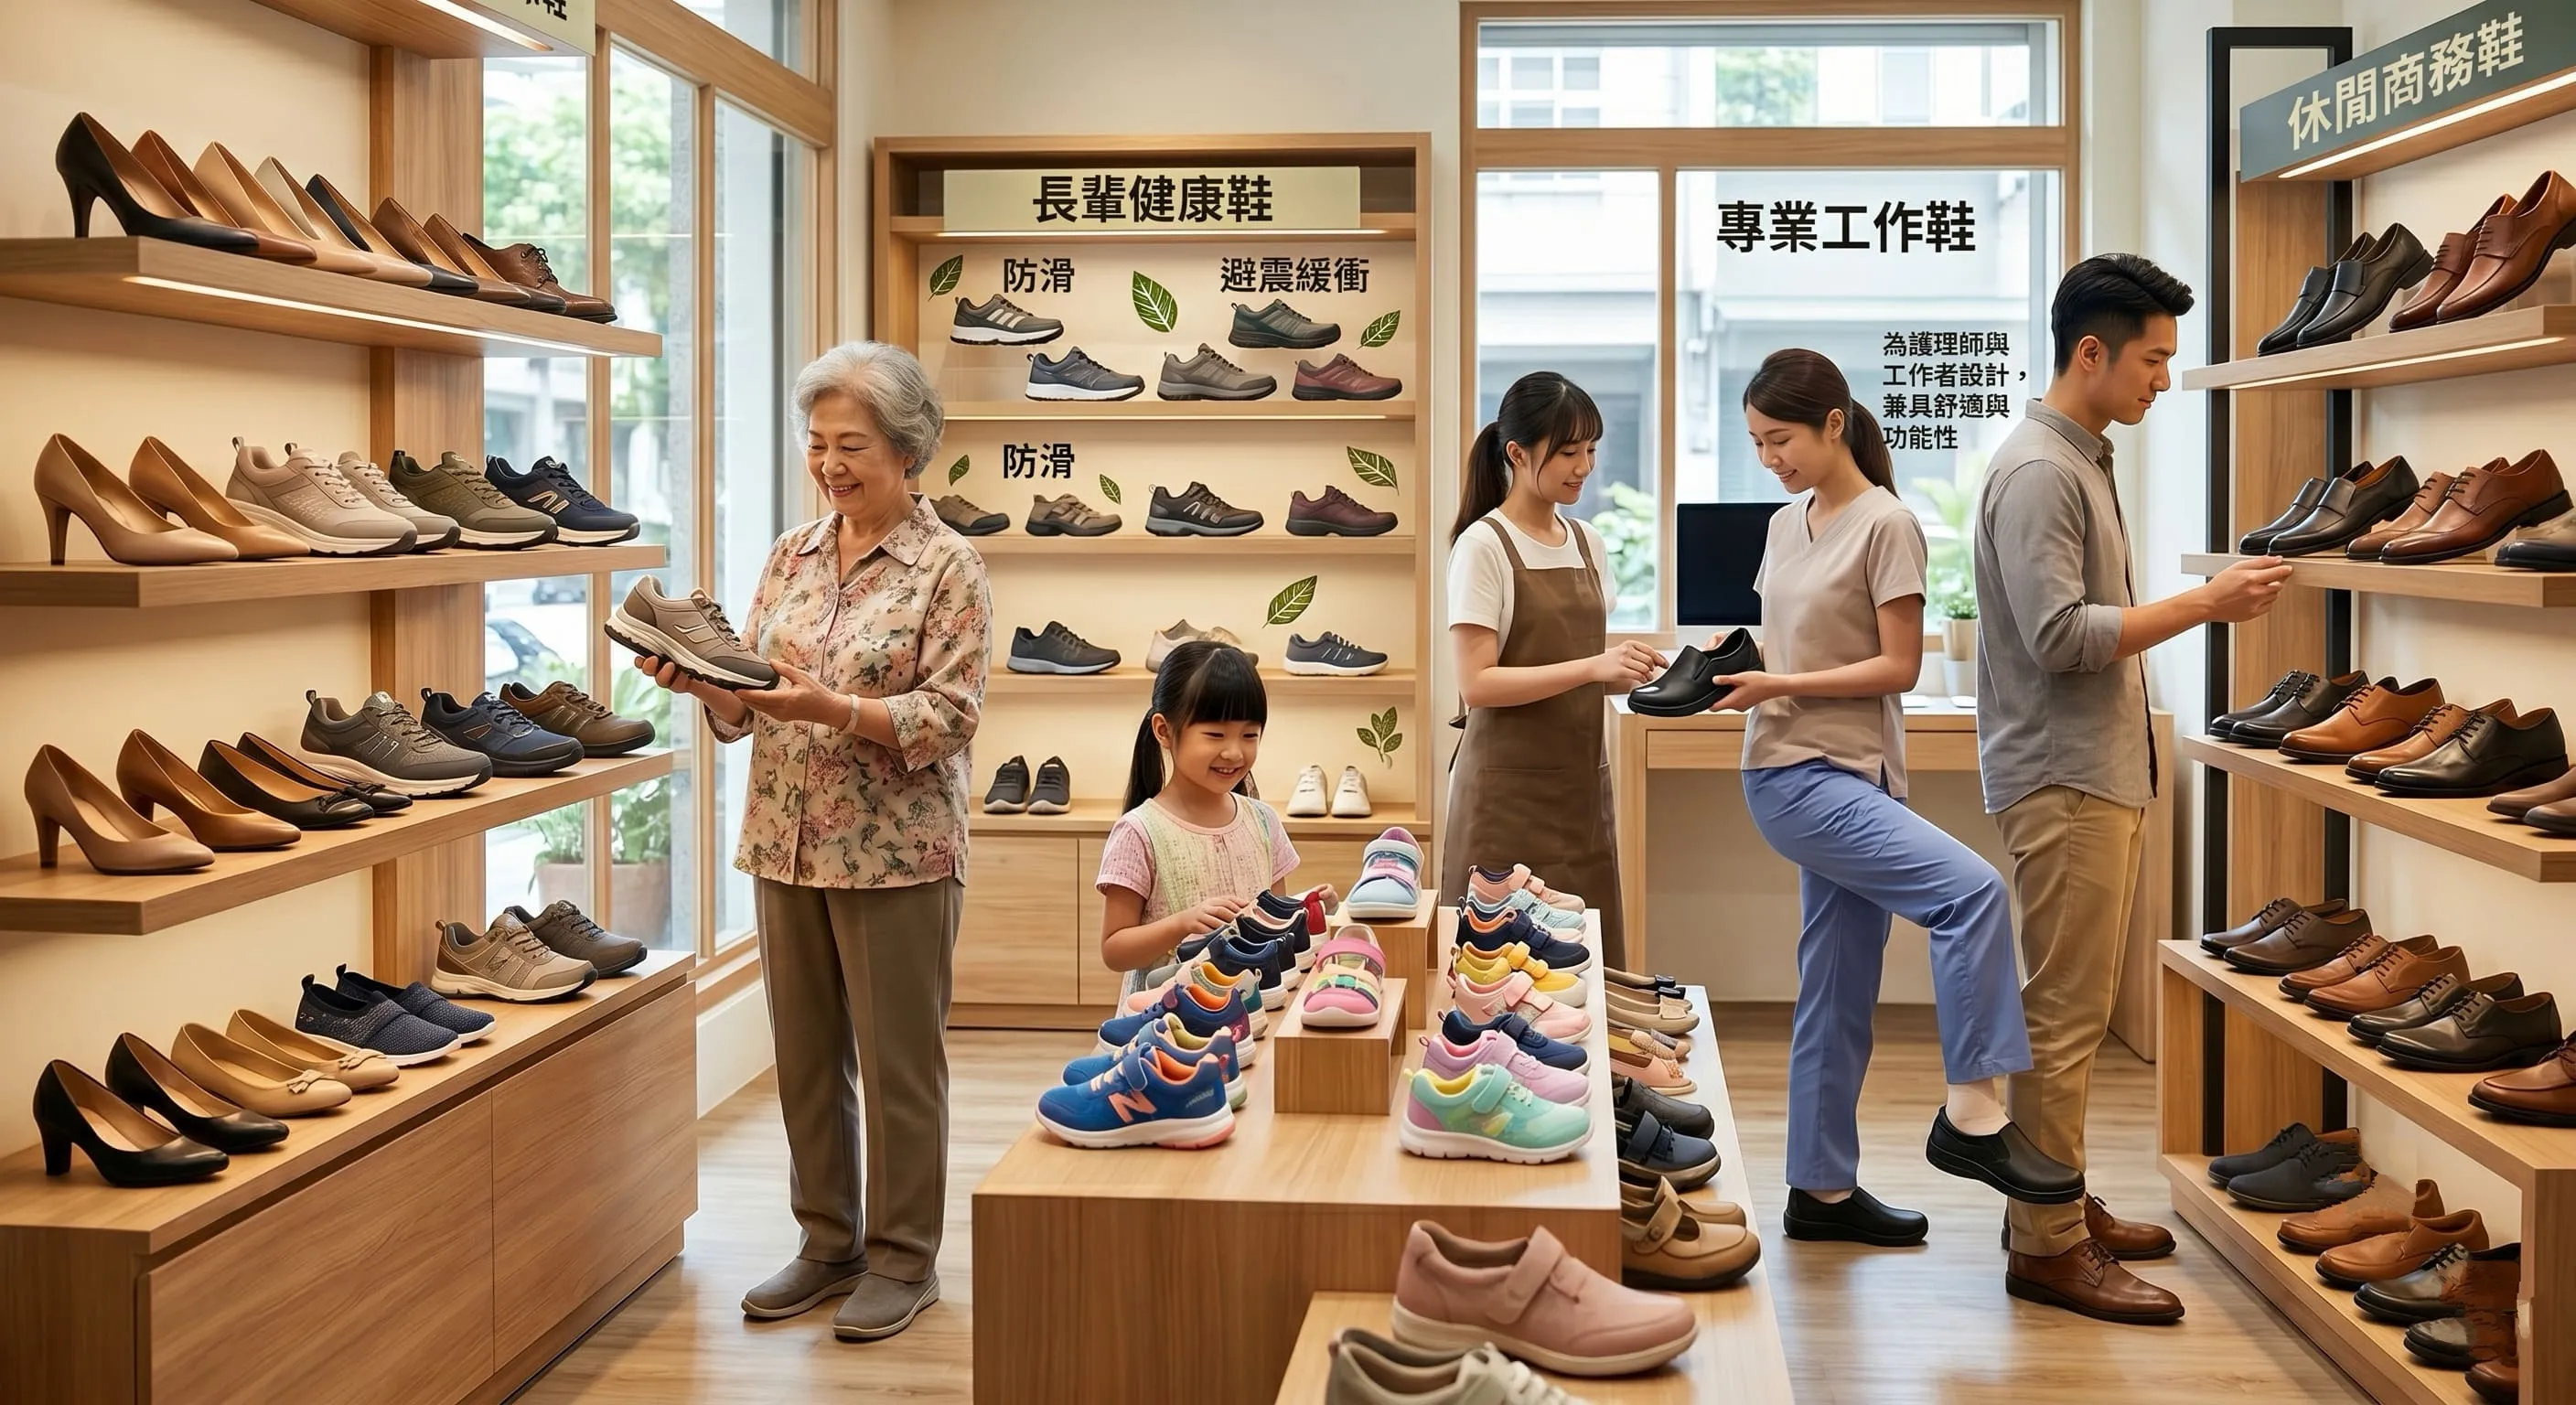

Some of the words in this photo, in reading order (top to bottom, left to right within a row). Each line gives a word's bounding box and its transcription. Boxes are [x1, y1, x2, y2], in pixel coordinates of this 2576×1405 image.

[2288, 11, 2524, 151] 休閒商務鞋
[1033, 175, 1272, 222] 長輩健康鞋
[1717, 200, 1975, 252] 專業工作鞋
[1004, 257, 1075, 293] 防滑
[1220, 257, 1368, 293] 避震緩衝
[1883, 331, 2010, 357] 為護理師與
[1883, 393, 2010, 418] 兼具舒適與
[1883, 425, 1958, 450] 功能性
[1004, 443, 1075, 478] 防滑
